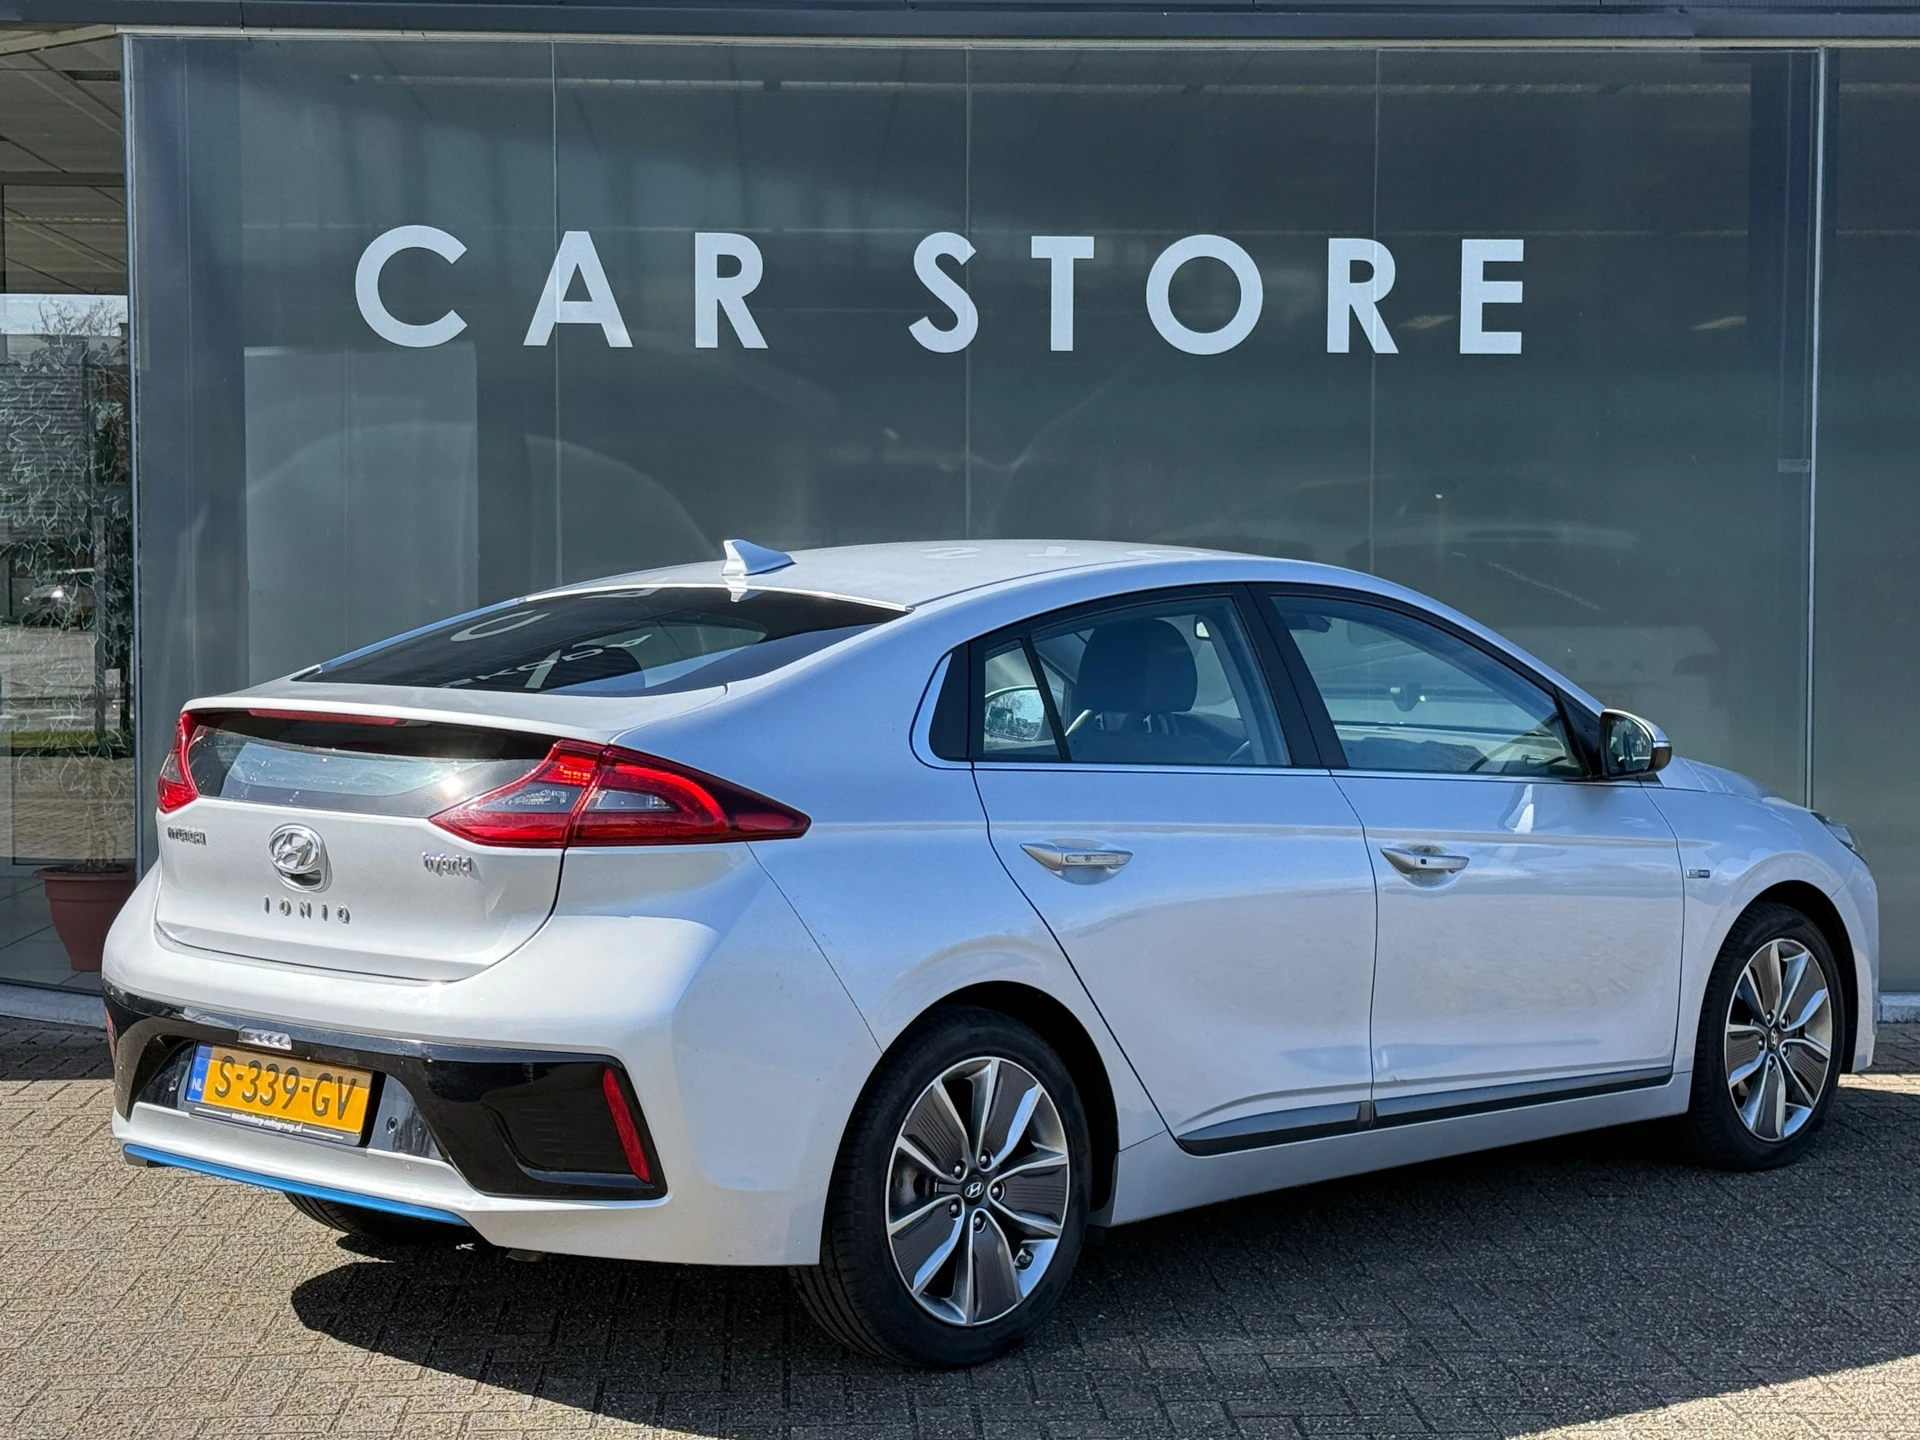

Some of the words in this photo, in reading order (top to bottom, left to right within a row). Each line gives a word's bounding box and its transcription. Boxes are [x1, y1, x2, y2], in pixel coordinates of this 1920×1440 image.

[355, 225, 768, 348] CAR
[909, 231, 1523, 354] STORE
[264, 895, 351, 924] IONIQ
[192, 1077, 202, 1091] NL
[215, 1055, 357, 1120] S-339-GV
